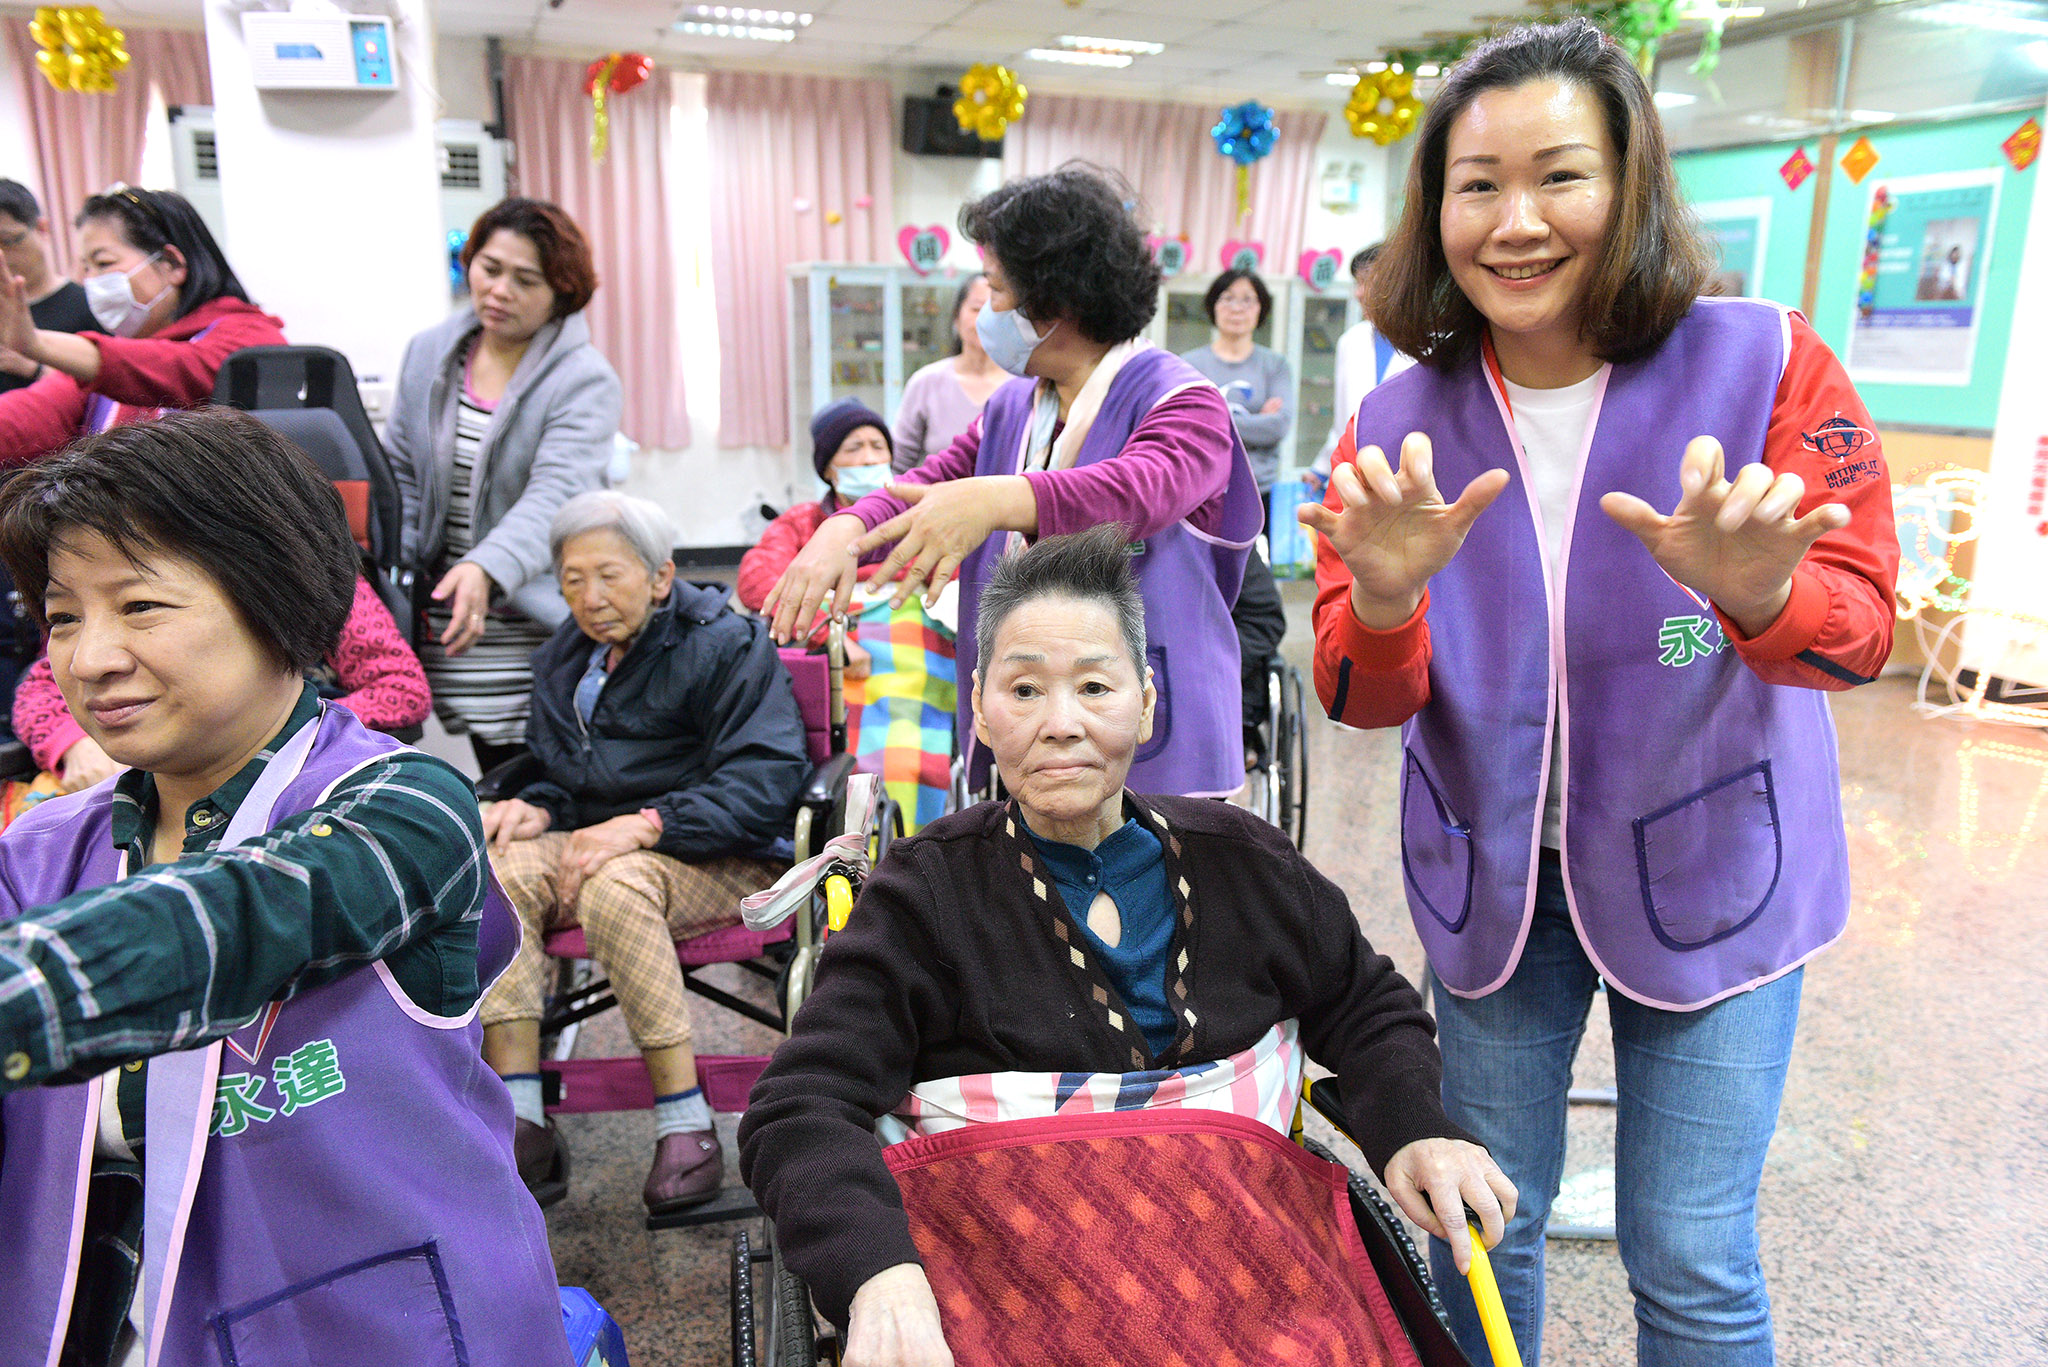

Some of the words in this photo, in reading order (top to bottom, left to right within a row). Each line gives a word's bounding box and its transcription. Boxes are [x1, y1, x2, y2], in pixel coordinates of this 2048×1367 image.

[1825, 461, 1867, 483] HITTING
[1869, 460, 1877, 469] IT
[1658, 615, 1733, 668] 永
[208, 1038, 346, 1138] 永達
